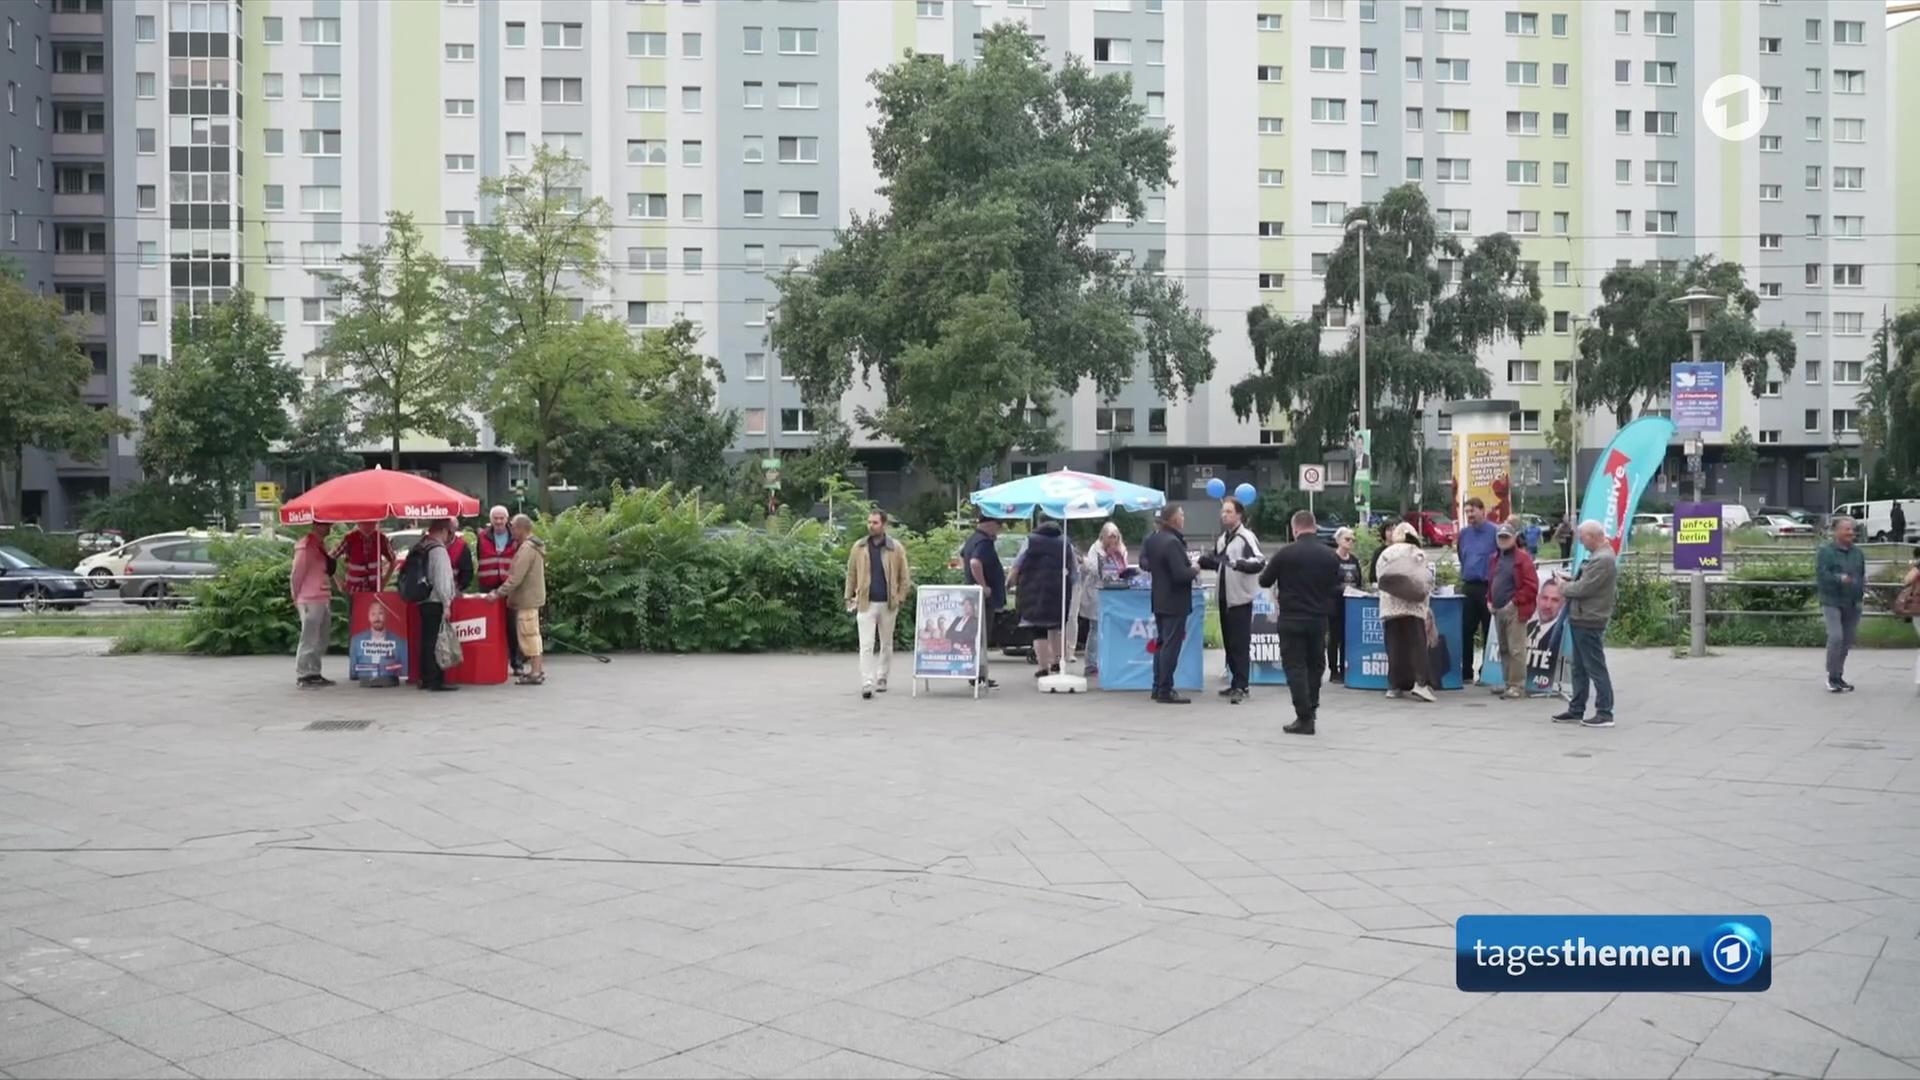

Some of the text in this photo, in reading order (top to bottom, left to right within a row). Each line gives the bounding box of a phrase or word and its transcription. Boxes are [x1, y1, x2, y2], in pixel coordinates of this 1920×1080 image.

[405, 505, 420, 516] Die
[1679, 533, 1707, 541] berlin
[1699, 557, 1718, 567] Volt
[455, 624, 481, 638] inke
